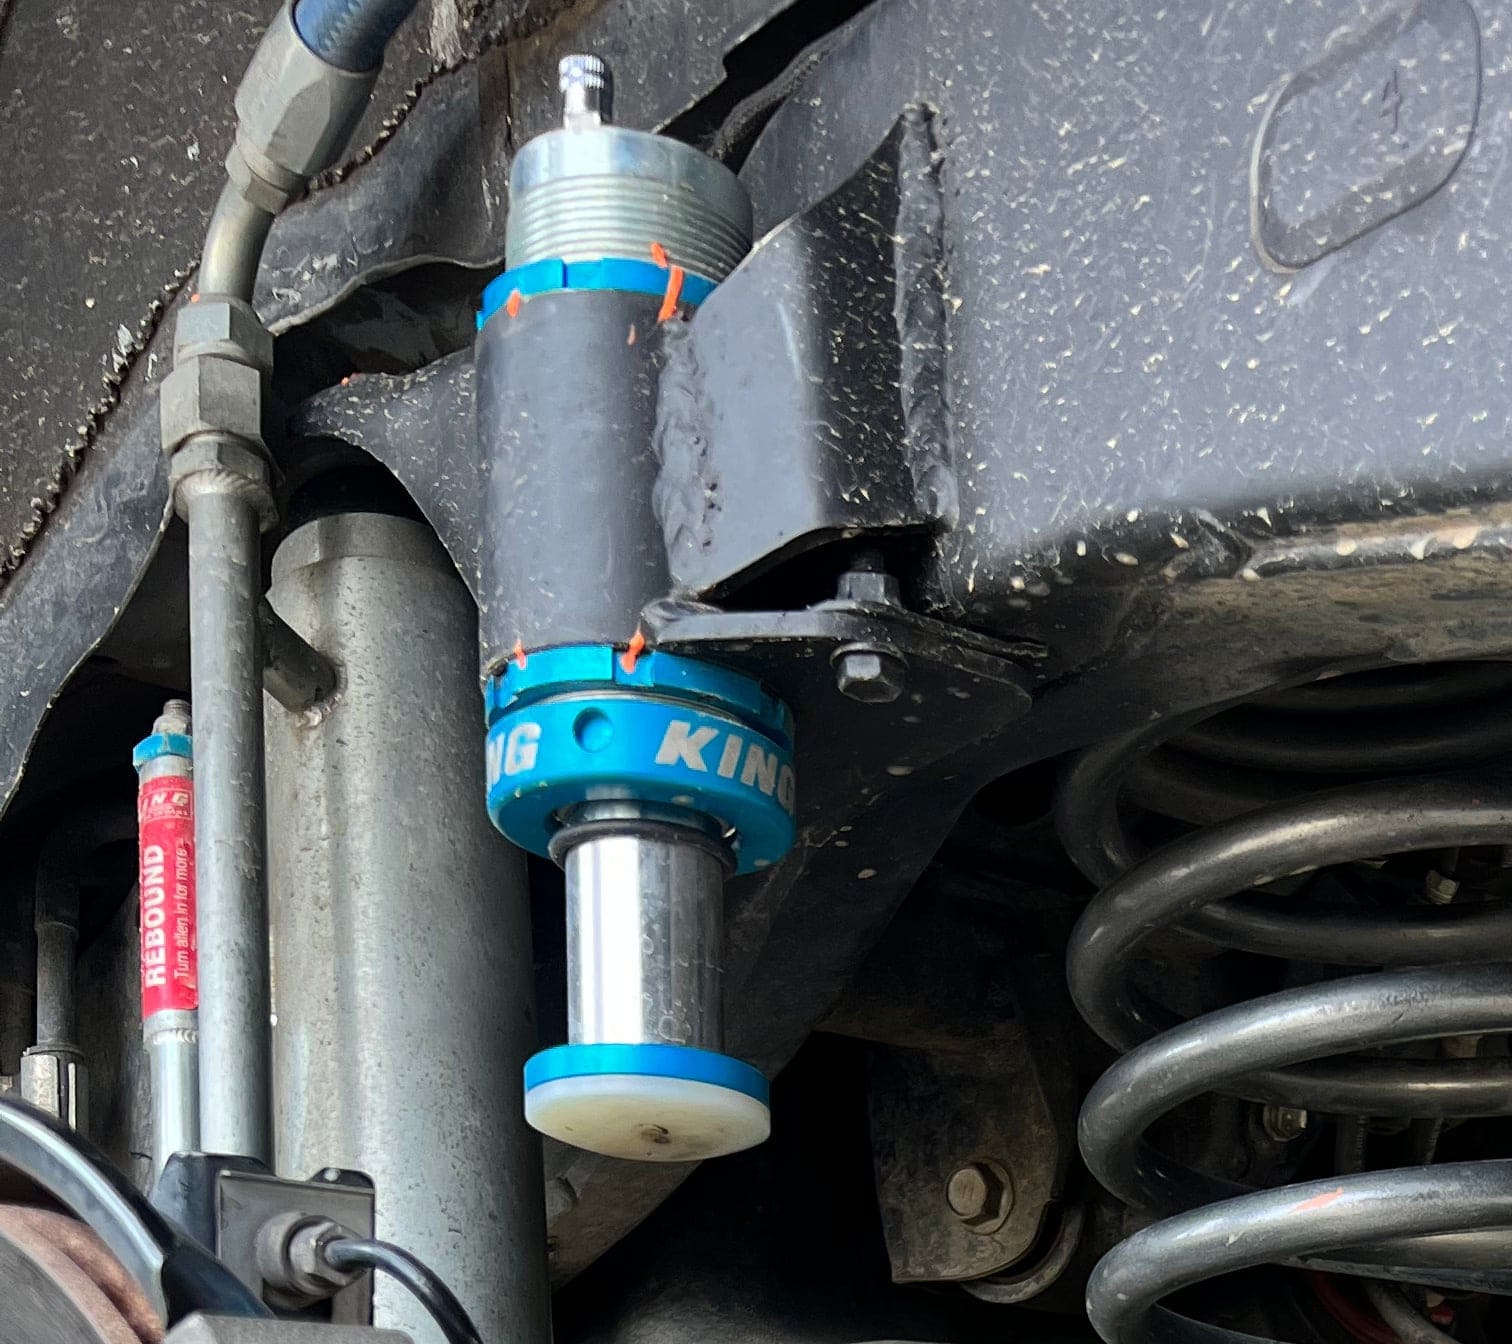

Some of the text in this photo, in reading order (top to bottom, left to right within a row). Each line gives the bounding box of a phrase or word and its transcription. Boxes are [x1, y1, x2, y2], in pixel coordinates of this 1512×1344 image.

[174, 848, 189, 881] more
[143, 844, 167, 988] REBOUND
[174, 903, 189, 915] in
